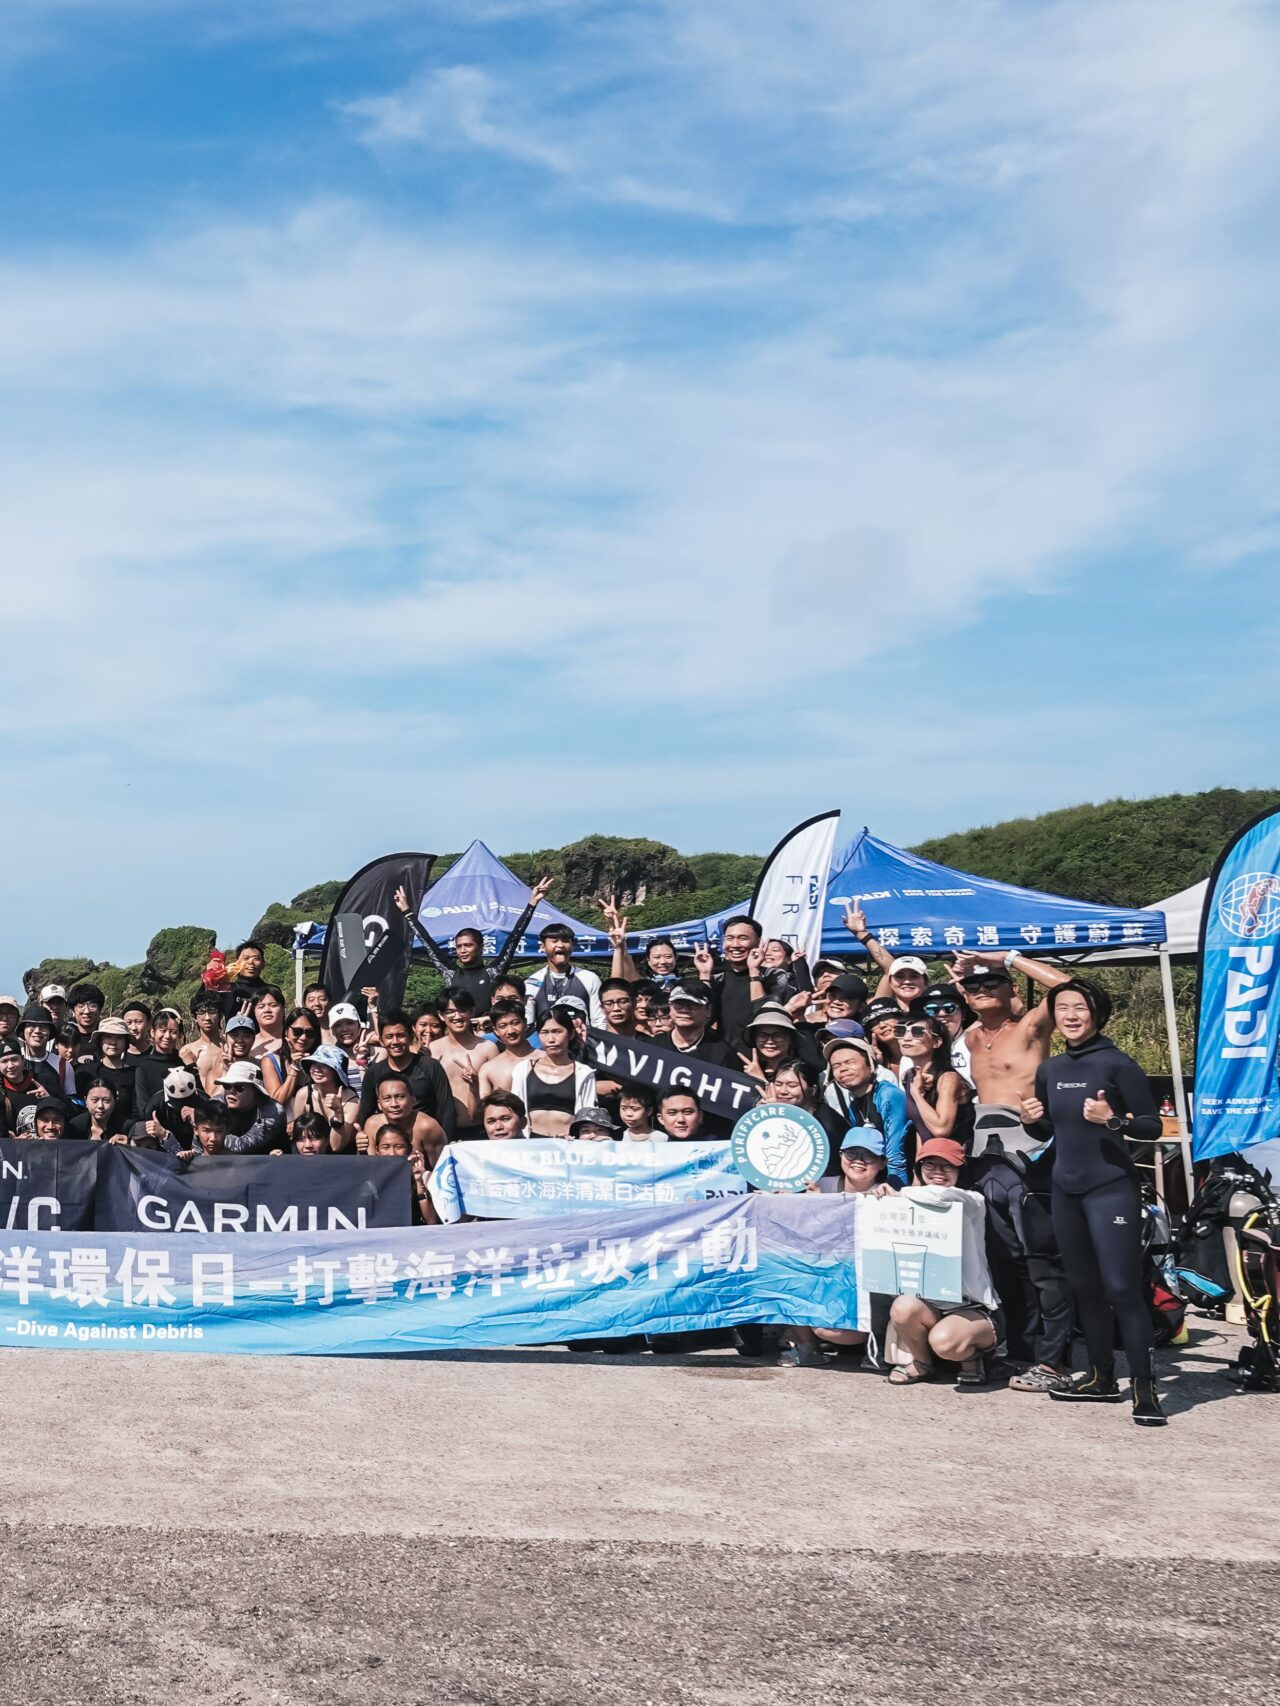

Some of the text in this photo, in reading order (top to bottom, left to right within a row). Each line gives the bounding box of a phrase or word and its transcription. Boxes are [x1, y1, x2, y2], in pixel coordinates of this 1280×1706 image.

[851, 890, 892, 901] PADI
[878, 926, 1000, 947] 探索奇遇
[1221, 945, 1274, 1059] PADI
[735, 1107, 786, 1163] PURIFYCARE
[137, 1194, 366, 1233] GARMIN
[64, 1322, 137, 1341] Against
[142, 1323, 204, 1340] Debris
